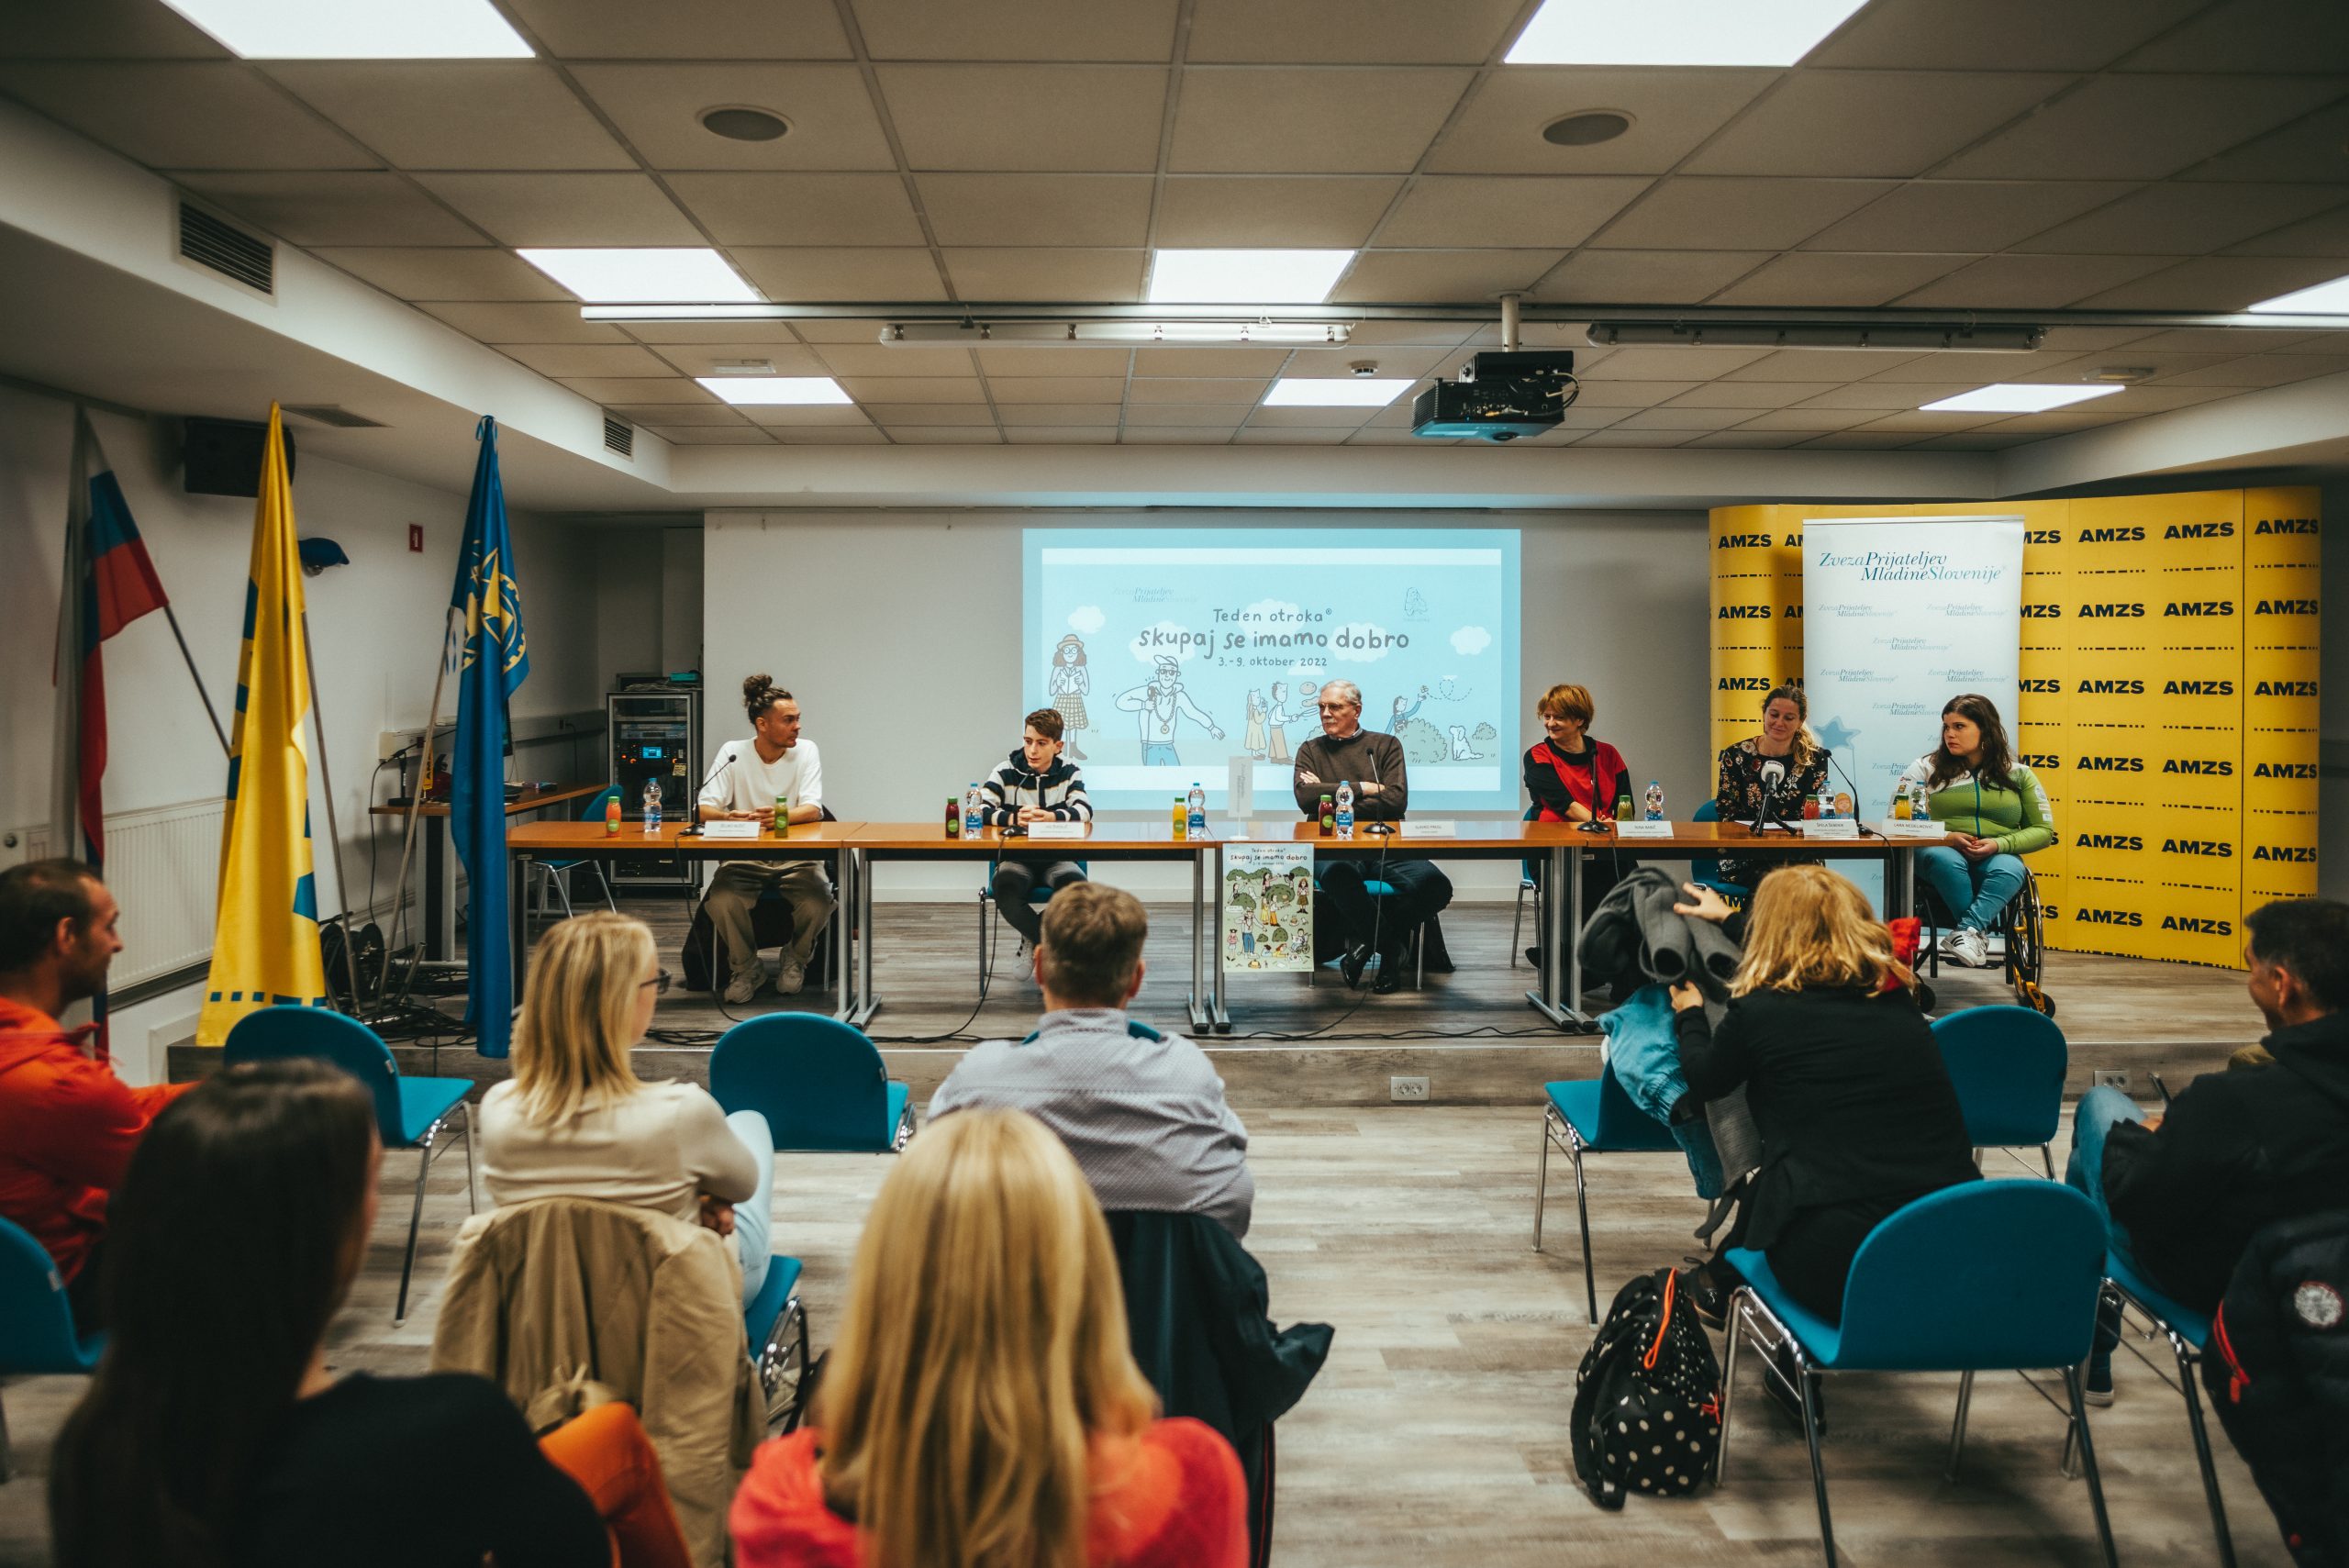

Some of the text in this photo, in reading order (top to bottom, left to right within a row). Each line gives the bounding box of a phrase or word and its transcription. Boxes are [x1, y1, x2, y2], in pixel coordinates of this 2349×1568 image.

[2164, 523, 2234, 539] AMZS
[2254, 519, 2319, 535] AMZS
[1718, 535, 1772, 550] AMZS
[2078, 528, 2145, 543] AMZS
[1718, 606, 1772, 619] AMZS
[2020, 605, 2061, 618] MZS
[2078, 604, 2145, 617] AMZS
[2164, 602, 2234, 617] AMZS
[2254, 600, 2319, 615] AMZS
[1213, 608, 1262, 623] Teden
[1139, 627, 1409, 660] skupaj se imamo dobro
[1249, 656, 1295, 666] oktober
[1300, 657, 1328, 667] 2022
[1717, 678, 1771, 691] AMZS
[2019, 680, 2061, 694] MZS
[2077, 681, 2144, 695] AMZS
[2163, 682, 2233, 695] AMZS
[2254, 682, 2319, 696] AMZS
[2019, 754, 2060, 769] MZS
[2077, 757, 2144, 773] AMZS
[2163, 760, 2233, 776] AMZS
[2254, 763, 2318, 779] AMZS
[2076, 834, 2143, 851] AMZS
[2162, 840, 2232, 858] AMZS
[2253, 846, 2317, 862] AMZS
[2076, 909, 2143, 927] AMZS
[2161, 917, 2232, 936] AMZS
